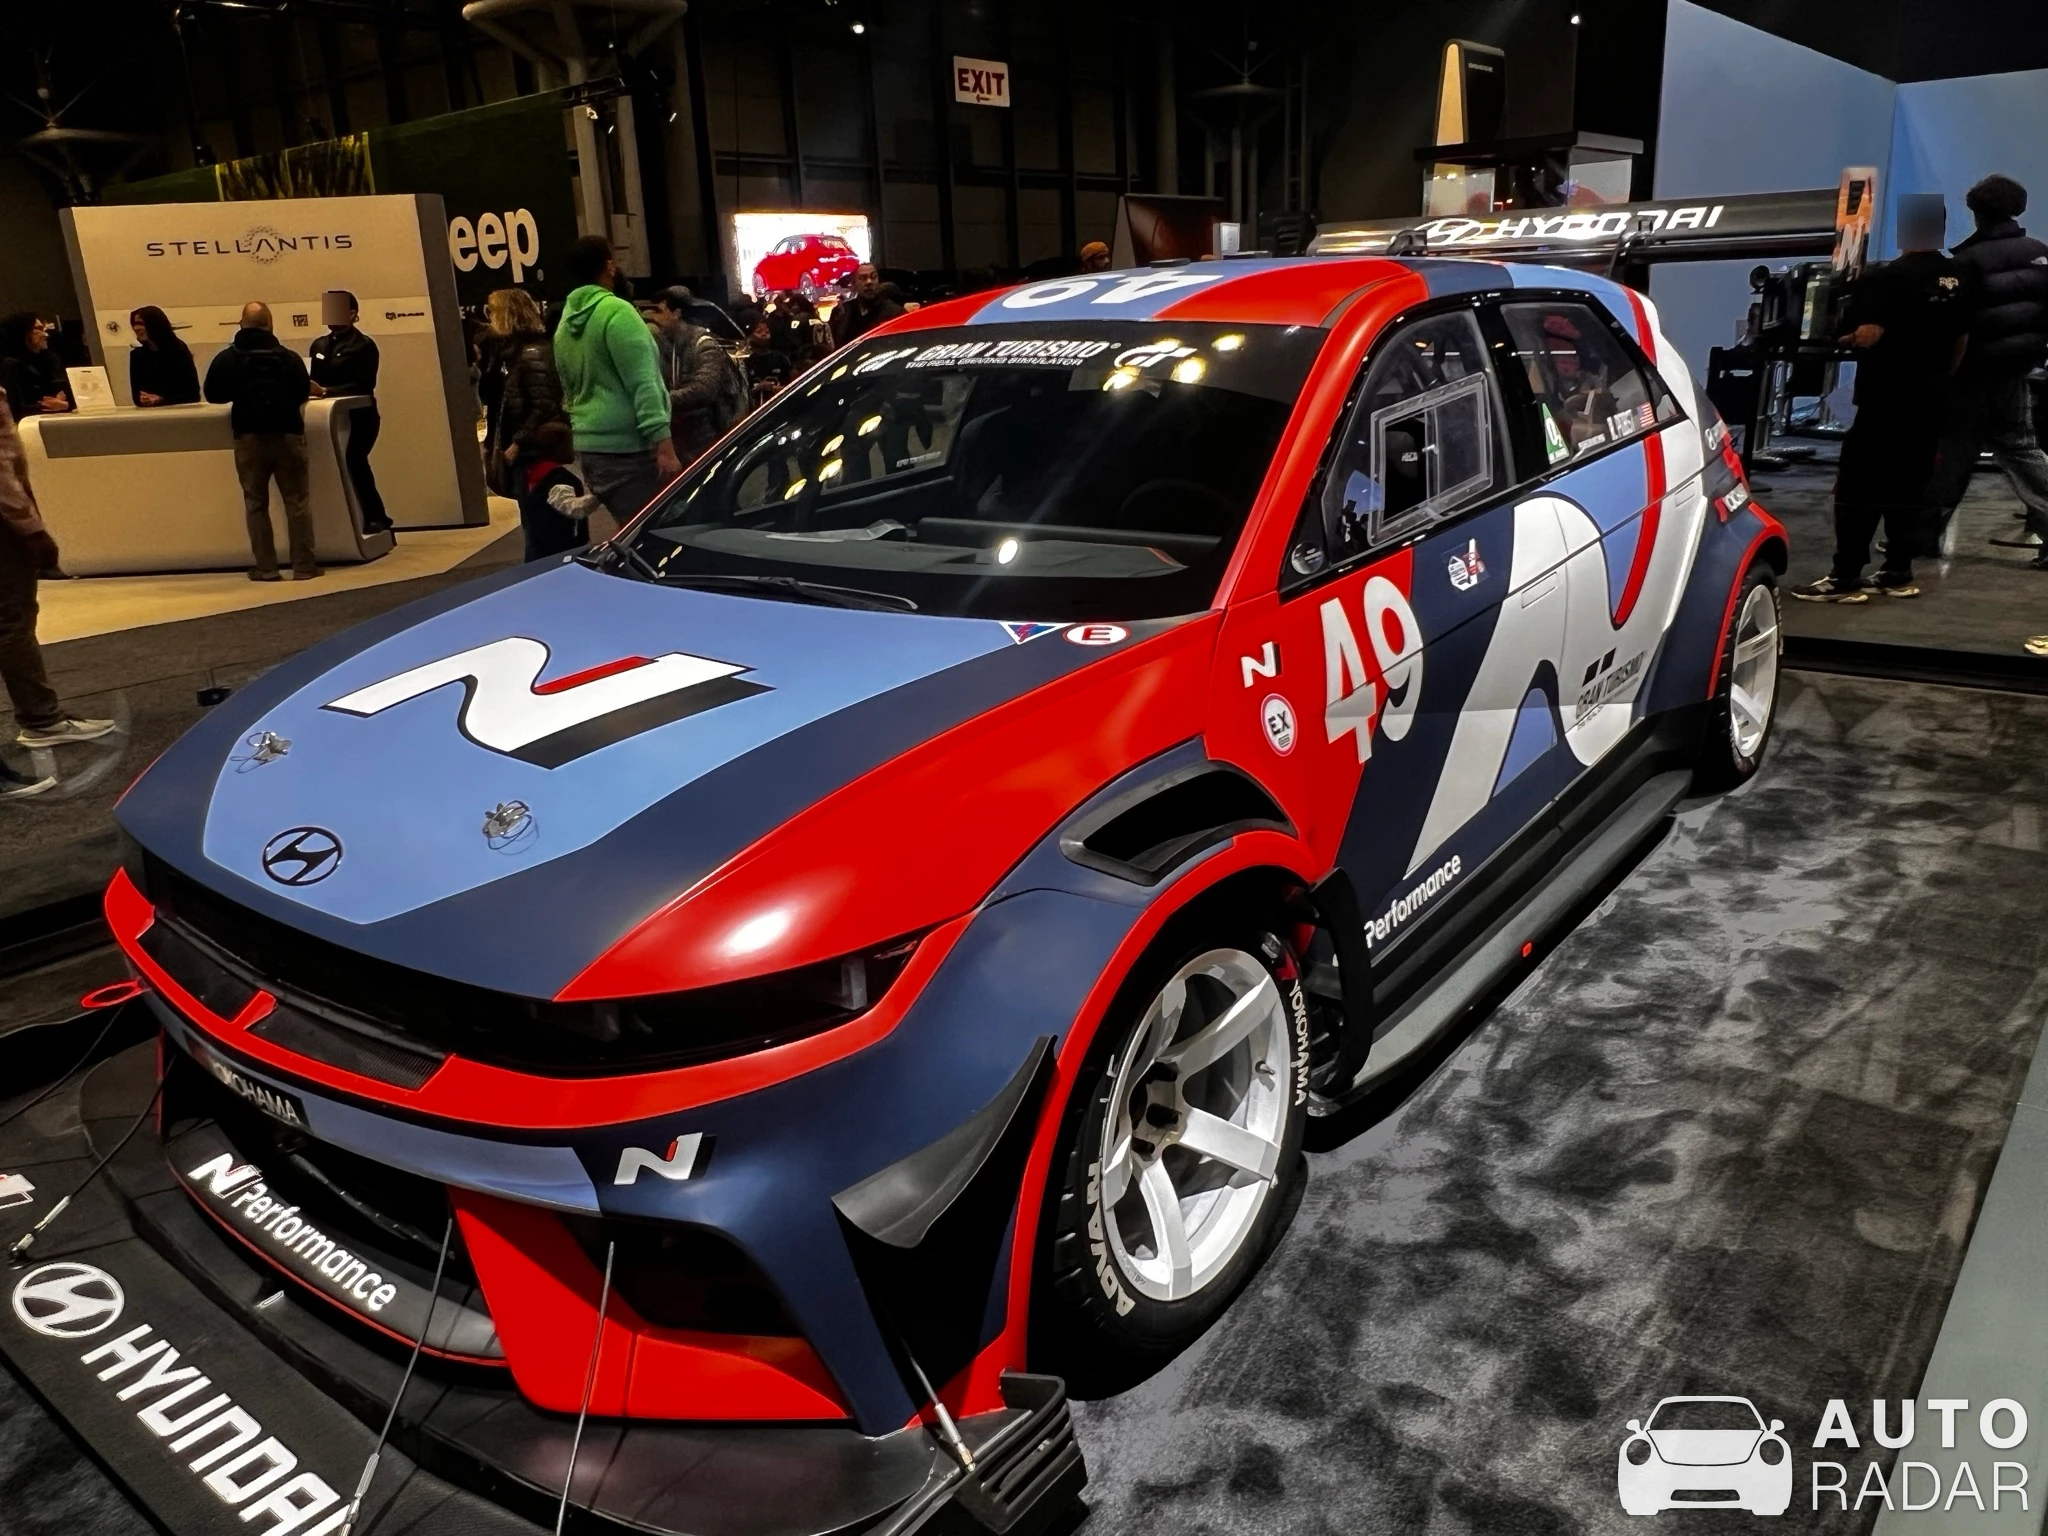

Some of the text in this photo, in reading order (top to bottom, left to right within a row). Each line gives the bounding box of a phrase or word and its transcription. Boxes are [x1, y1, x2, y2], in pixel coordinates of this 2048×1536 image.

[958, 68, 1004, 96] EXIT
[147, 235, 352, 256] STELLANTIS
[450, 208, 540, 283] eep
[917, 343, 986, 361] GRAN
[1241, 641, 1278, 688] N
[1320, 576, 1424, 764] 49
[1268, 710, 1290, 736] EX
[1364, 855, 1461, 949] Performance
[1288, 979, 1311, 1106] YOKOHAMA
[613, 1131, 704, 1185] N
[231, 1182, 397, 1311] Performance
[1086, 1160, 1136, 1317] ADVAN
